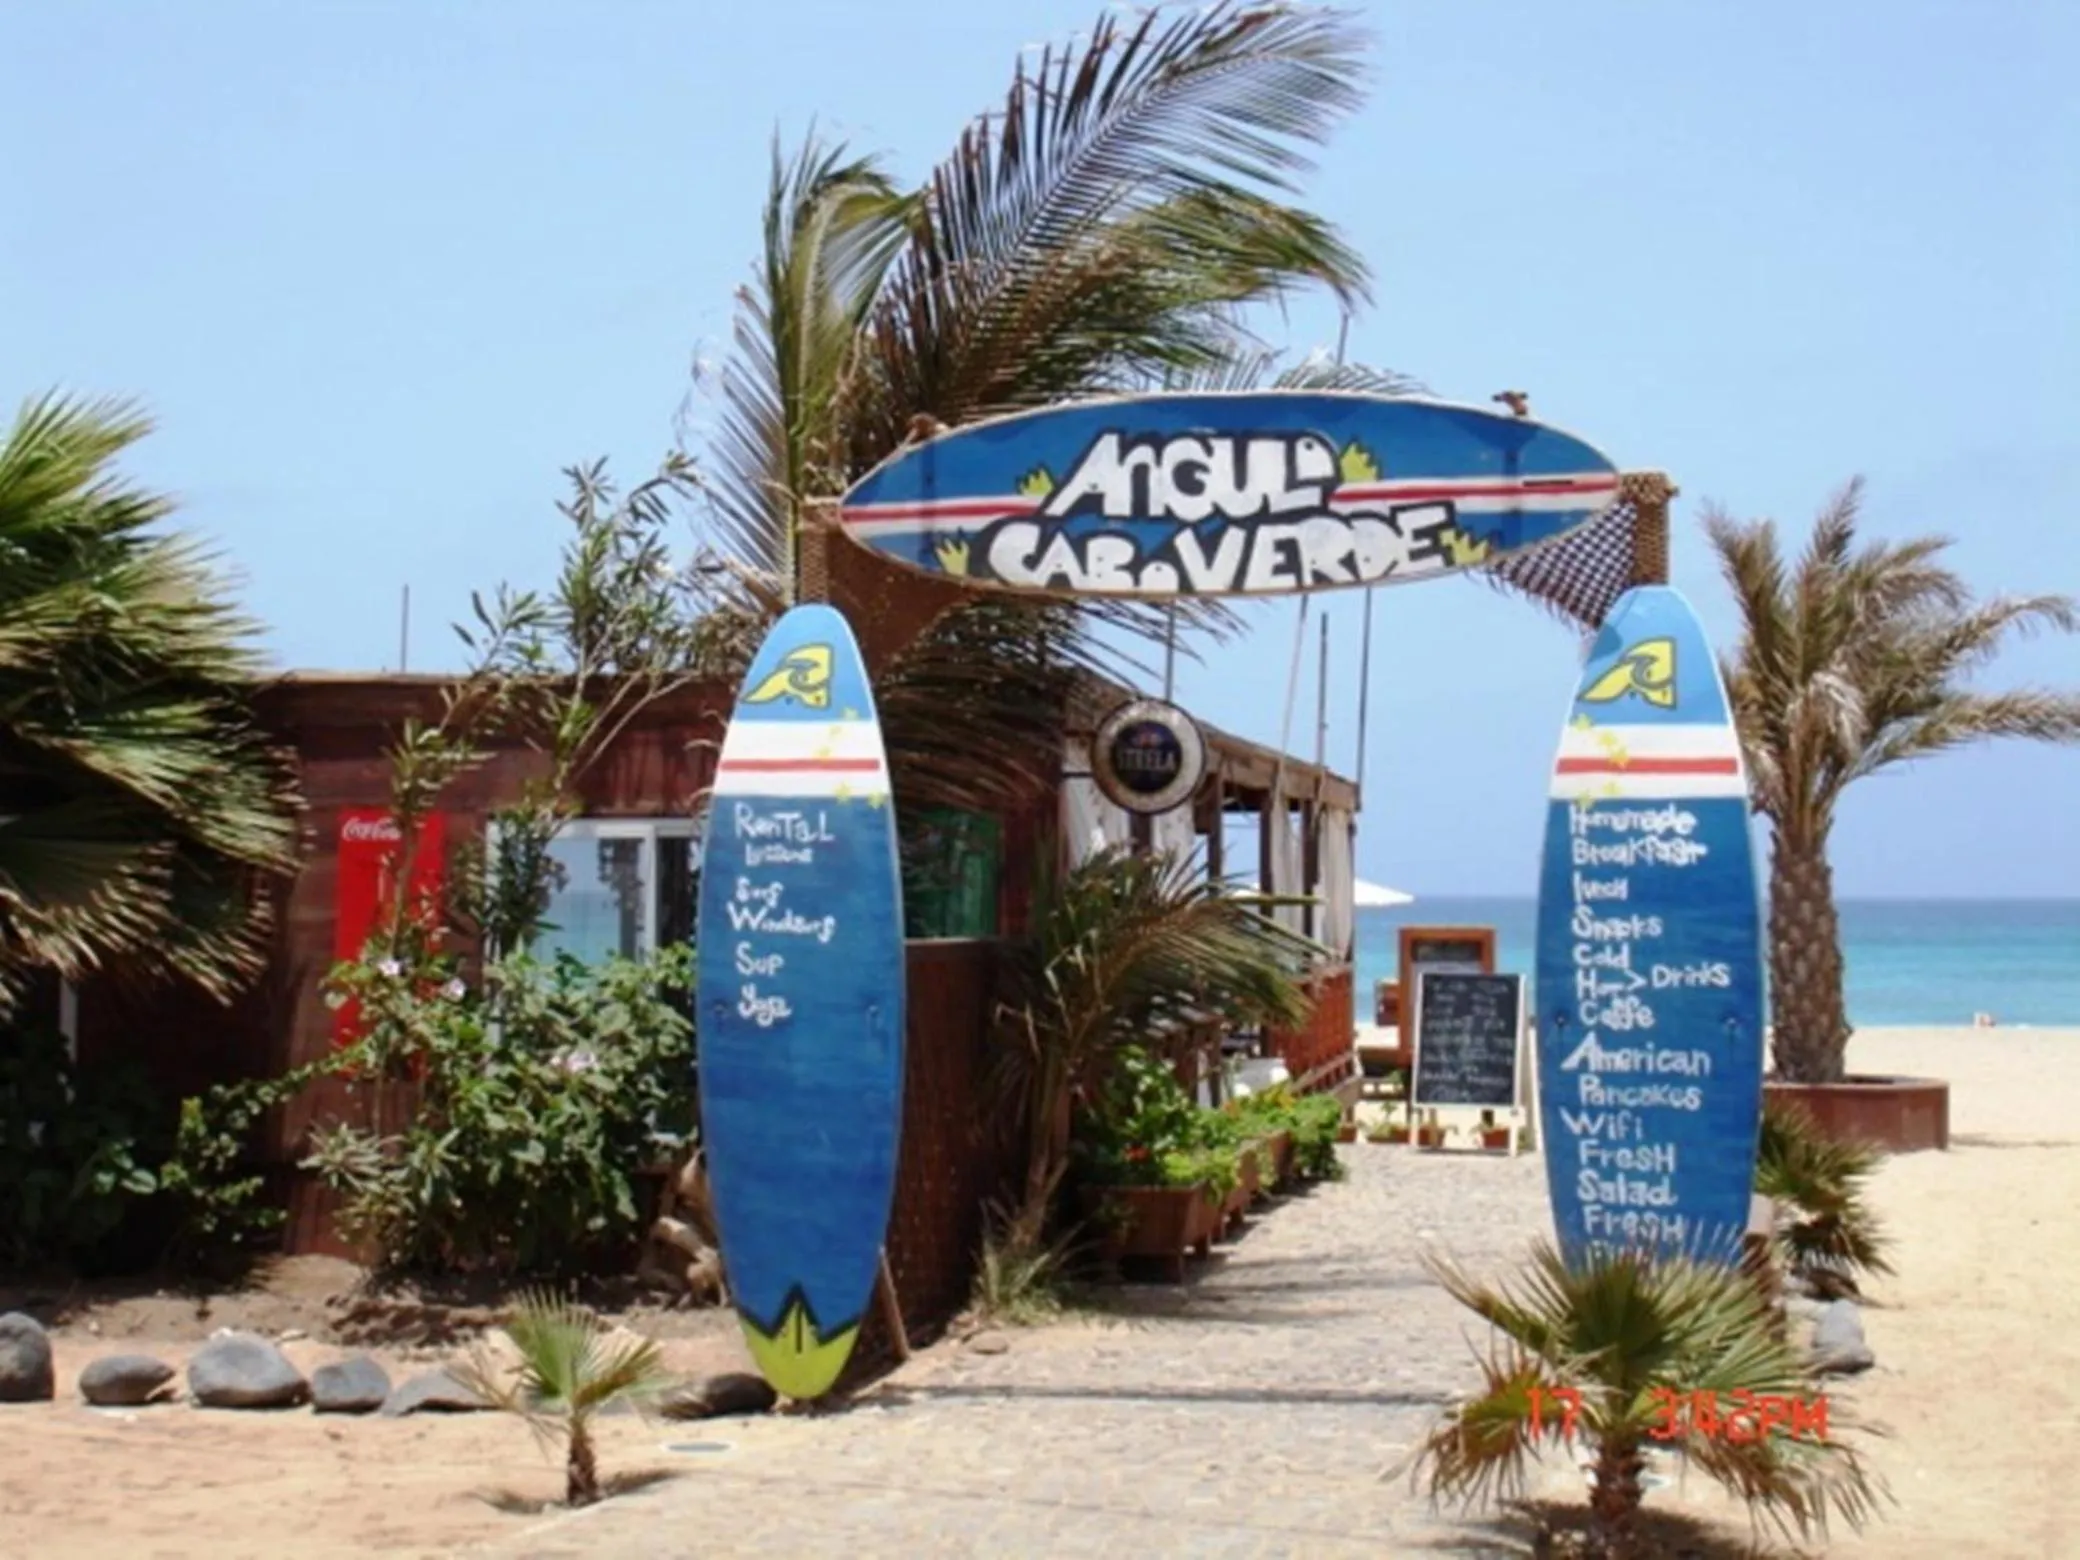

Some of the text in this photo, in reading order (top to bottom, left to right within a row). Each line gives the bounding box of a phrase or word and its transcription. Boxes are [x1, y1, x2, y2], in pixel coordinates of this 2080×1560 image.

[1172, 502, 1450, 594] VERDE
[1560, 1030, 1713, 1077] American
[1578, 1073, 1703, 1112] Pancakes
[1577, 1168, 1680, 1207] Salad
